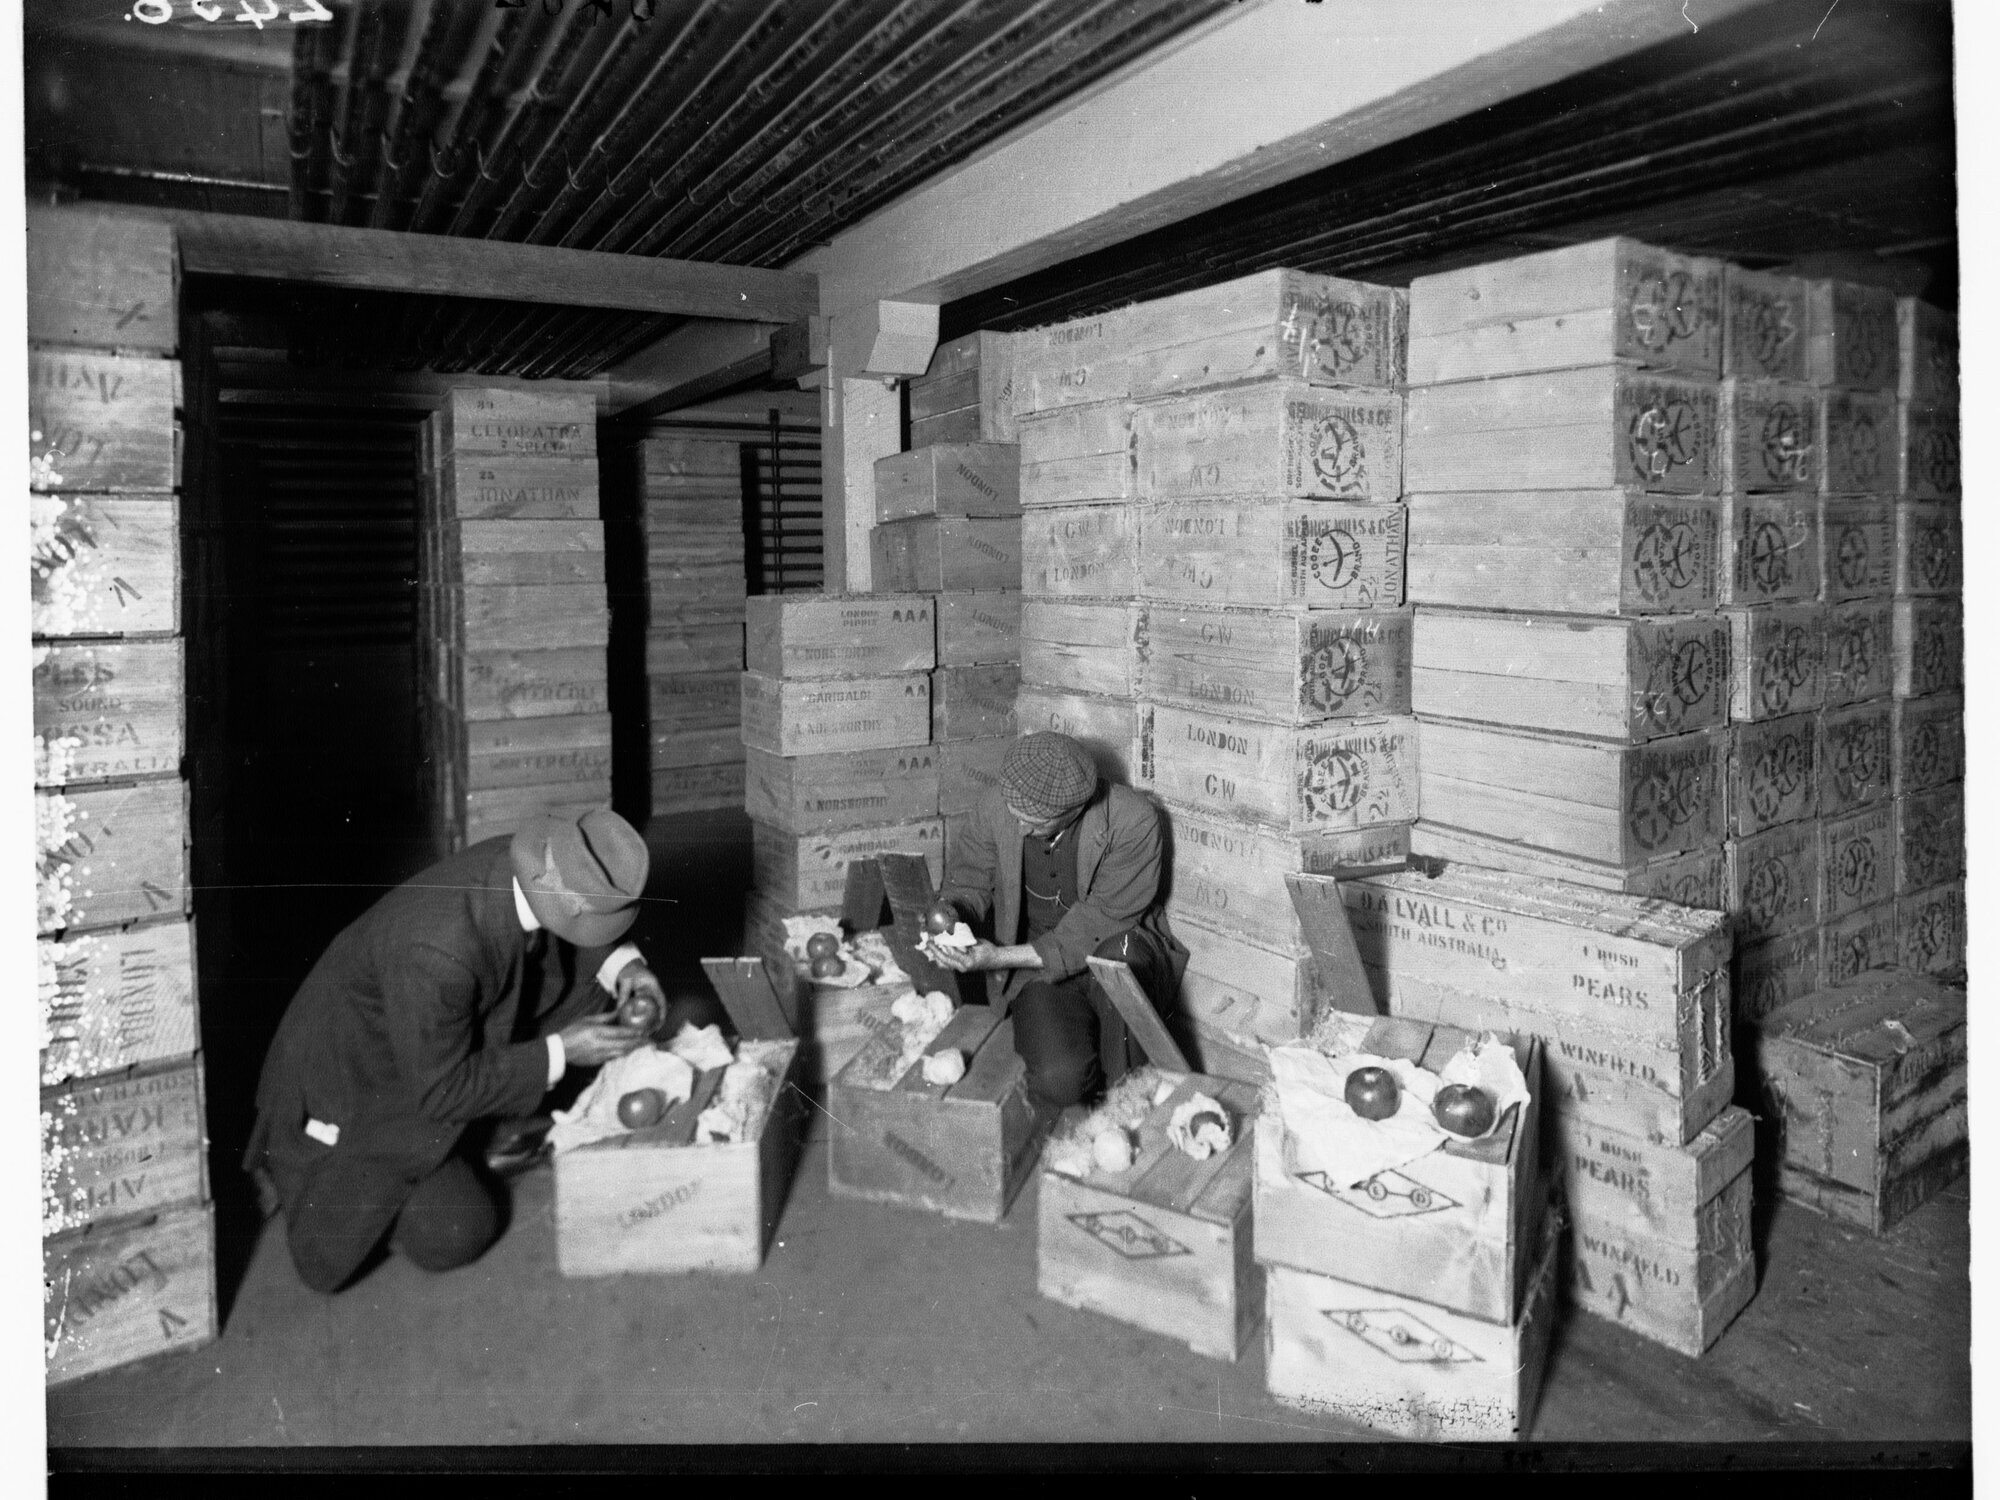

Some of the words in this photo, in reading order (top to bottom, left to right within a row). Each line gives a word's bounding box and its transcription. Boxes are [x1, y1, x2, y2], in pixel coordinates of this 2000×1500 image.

[956, 463, 999, 501] LONDON
[1369, 520, 1376, 535] &
[968, 536, 1010, 564] LONDON
[1311, 537, 1323, 580] COOEE
[1350, 541, 1363, 580] BRAND
[1384, 510, 1400, 603] JONATHAN
[1054, 562, 1105, 582] LONDON
[1200, 623, 1232, 645] GW
[59, 697, 122, 713] SOUND
[809, 690, 872, 704] GARIBALDI
[1188, 680, 1254, 705] LONDON
[1050, 712, 1075, 735] GW
[1187, 723, 1248, 756] LONDON
[1206, 774, 1236, 802] GW
[1360, 760, 1370, 798] BRAND
[1179, 824, 1244, 857] LONDON
[1396, 897, 1456, 929] LYALL
[1463, 913, 1476, 933] &
[1573, 974, 1650, 1009] PEARS
[1561, 1042, 1656, 1081] WINFIELD
[1575, 1155, 1650, 1199] PEARS
